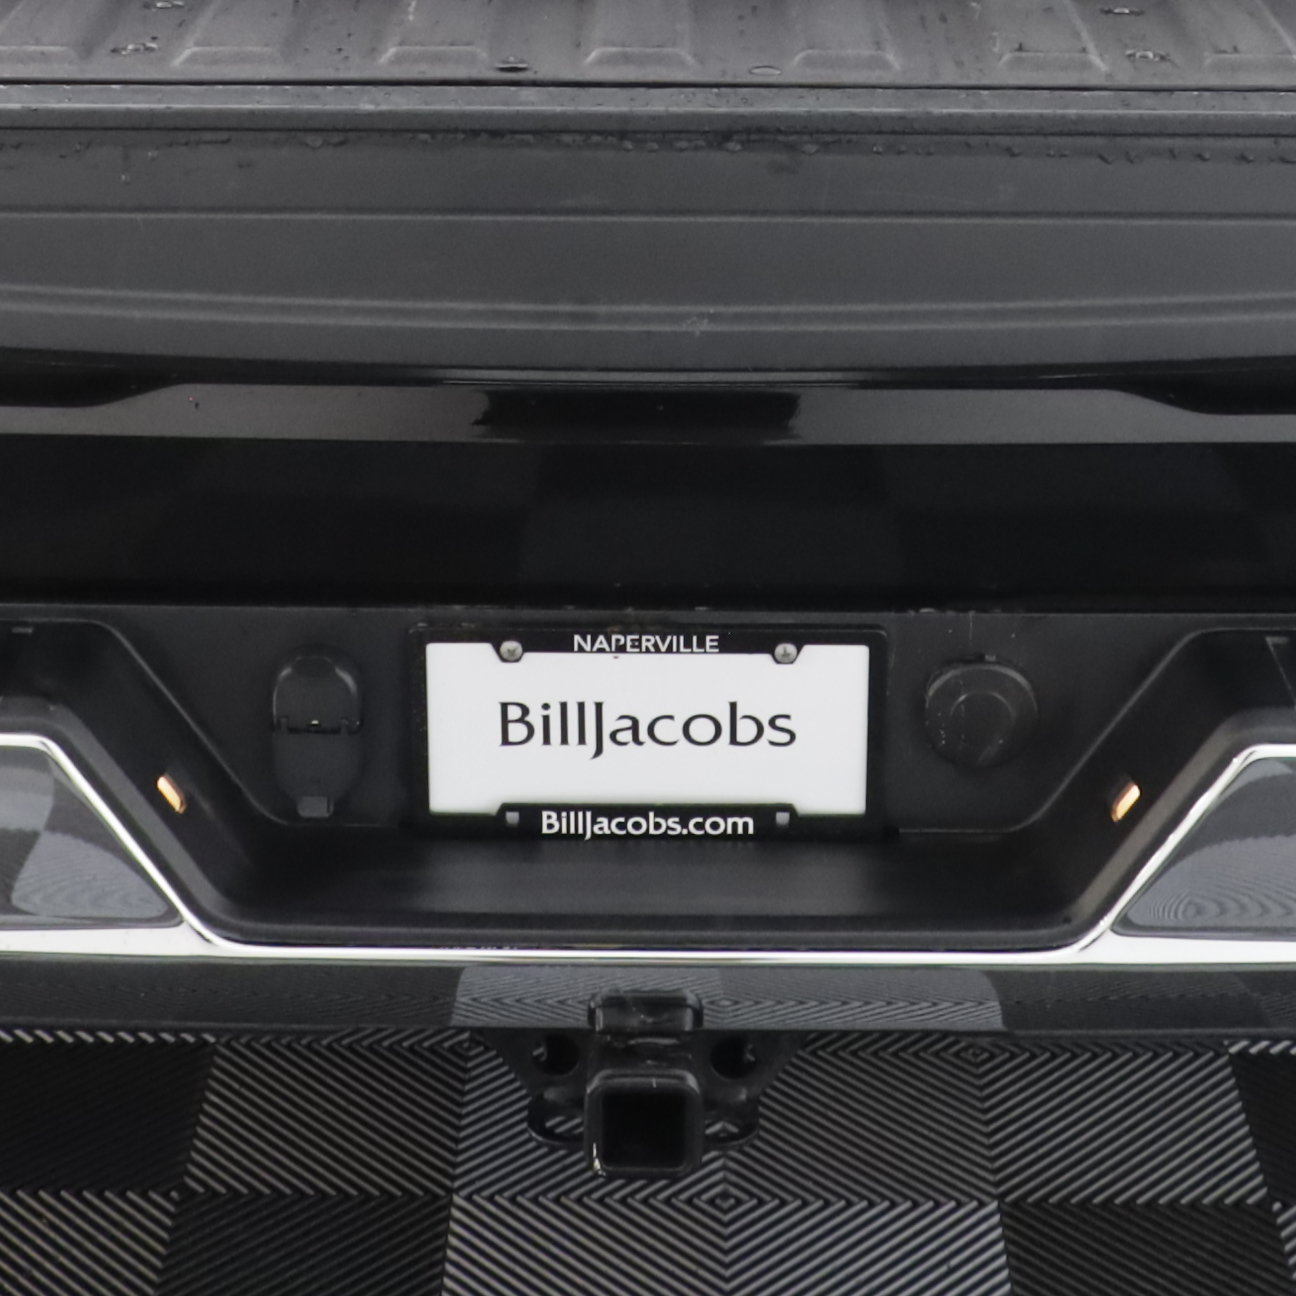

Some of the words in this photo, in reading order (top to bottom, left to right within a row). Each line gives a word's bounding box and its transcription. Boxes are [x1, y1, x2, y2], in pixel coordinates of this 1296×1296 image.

[573, 634, 719, 653] NAPERVILLE
[498, 701, 797, 760] BillJacobs
[540, 811, 754, 840] BillJacobs.com
